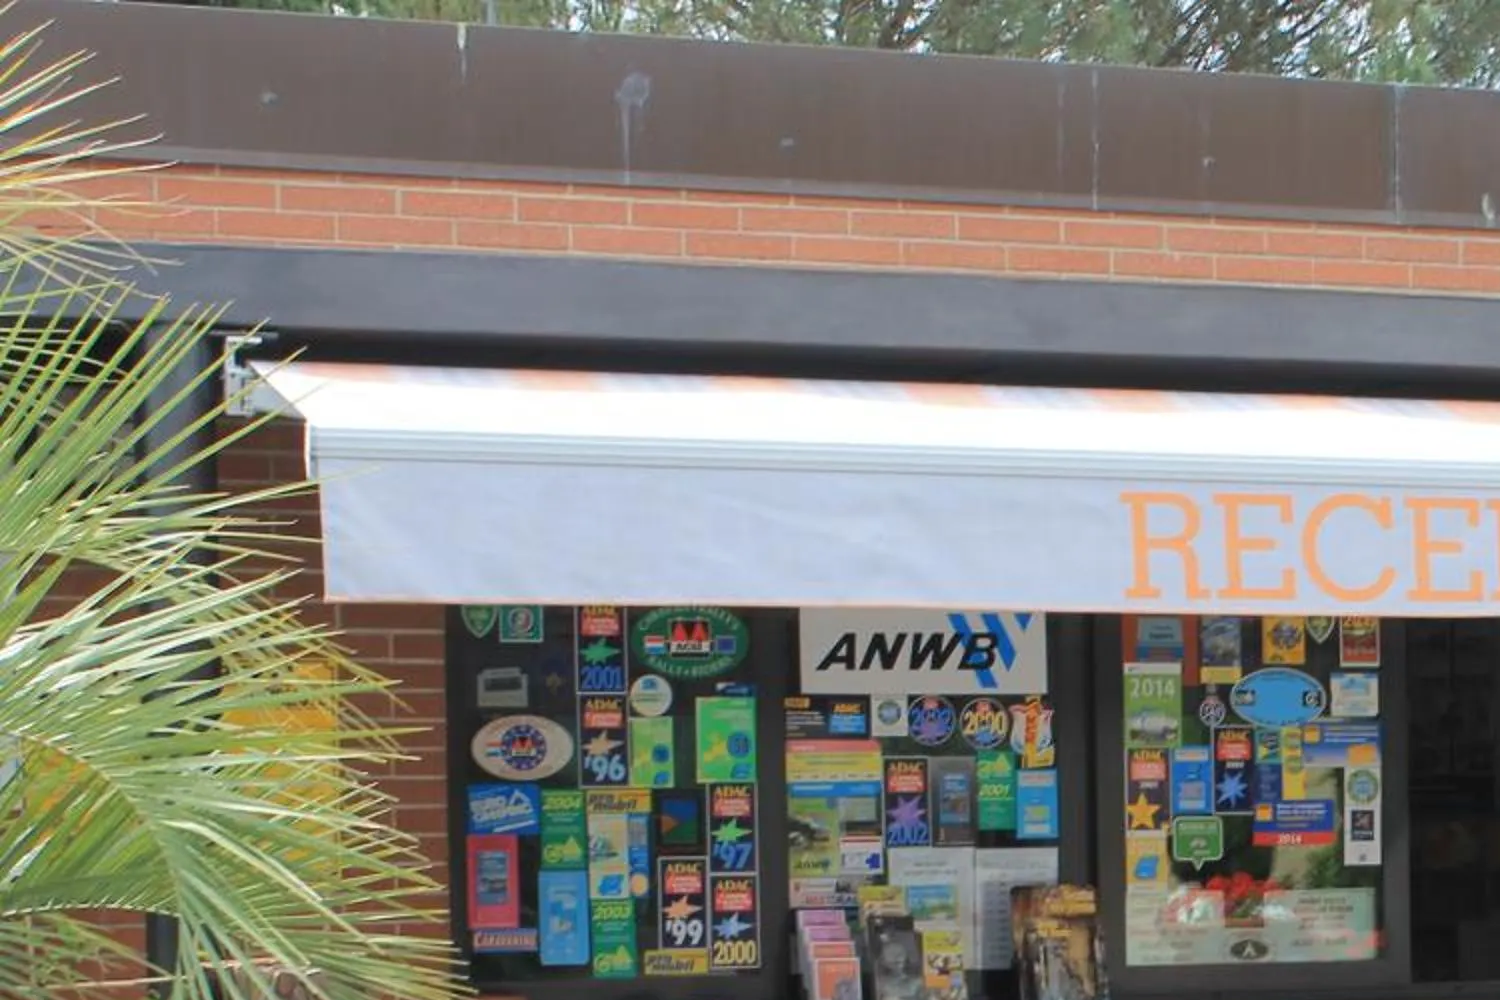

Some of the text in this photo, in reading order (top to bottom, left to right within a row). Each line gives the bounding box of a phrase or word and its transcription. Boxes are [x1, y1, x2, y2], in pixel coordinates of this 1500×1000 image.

[815, 632, 999, 671] ANWB
[582, 666, 622, 690] 2001
[1129, 677, 1176, 700] 2014
[583, 754, 626, 782] '96
[888, 823, 929, 847] 2002
[713, 842, 753, 870] '97
[664, 918, 704, 946] '99
[713, 940, 757, 965] 2000
